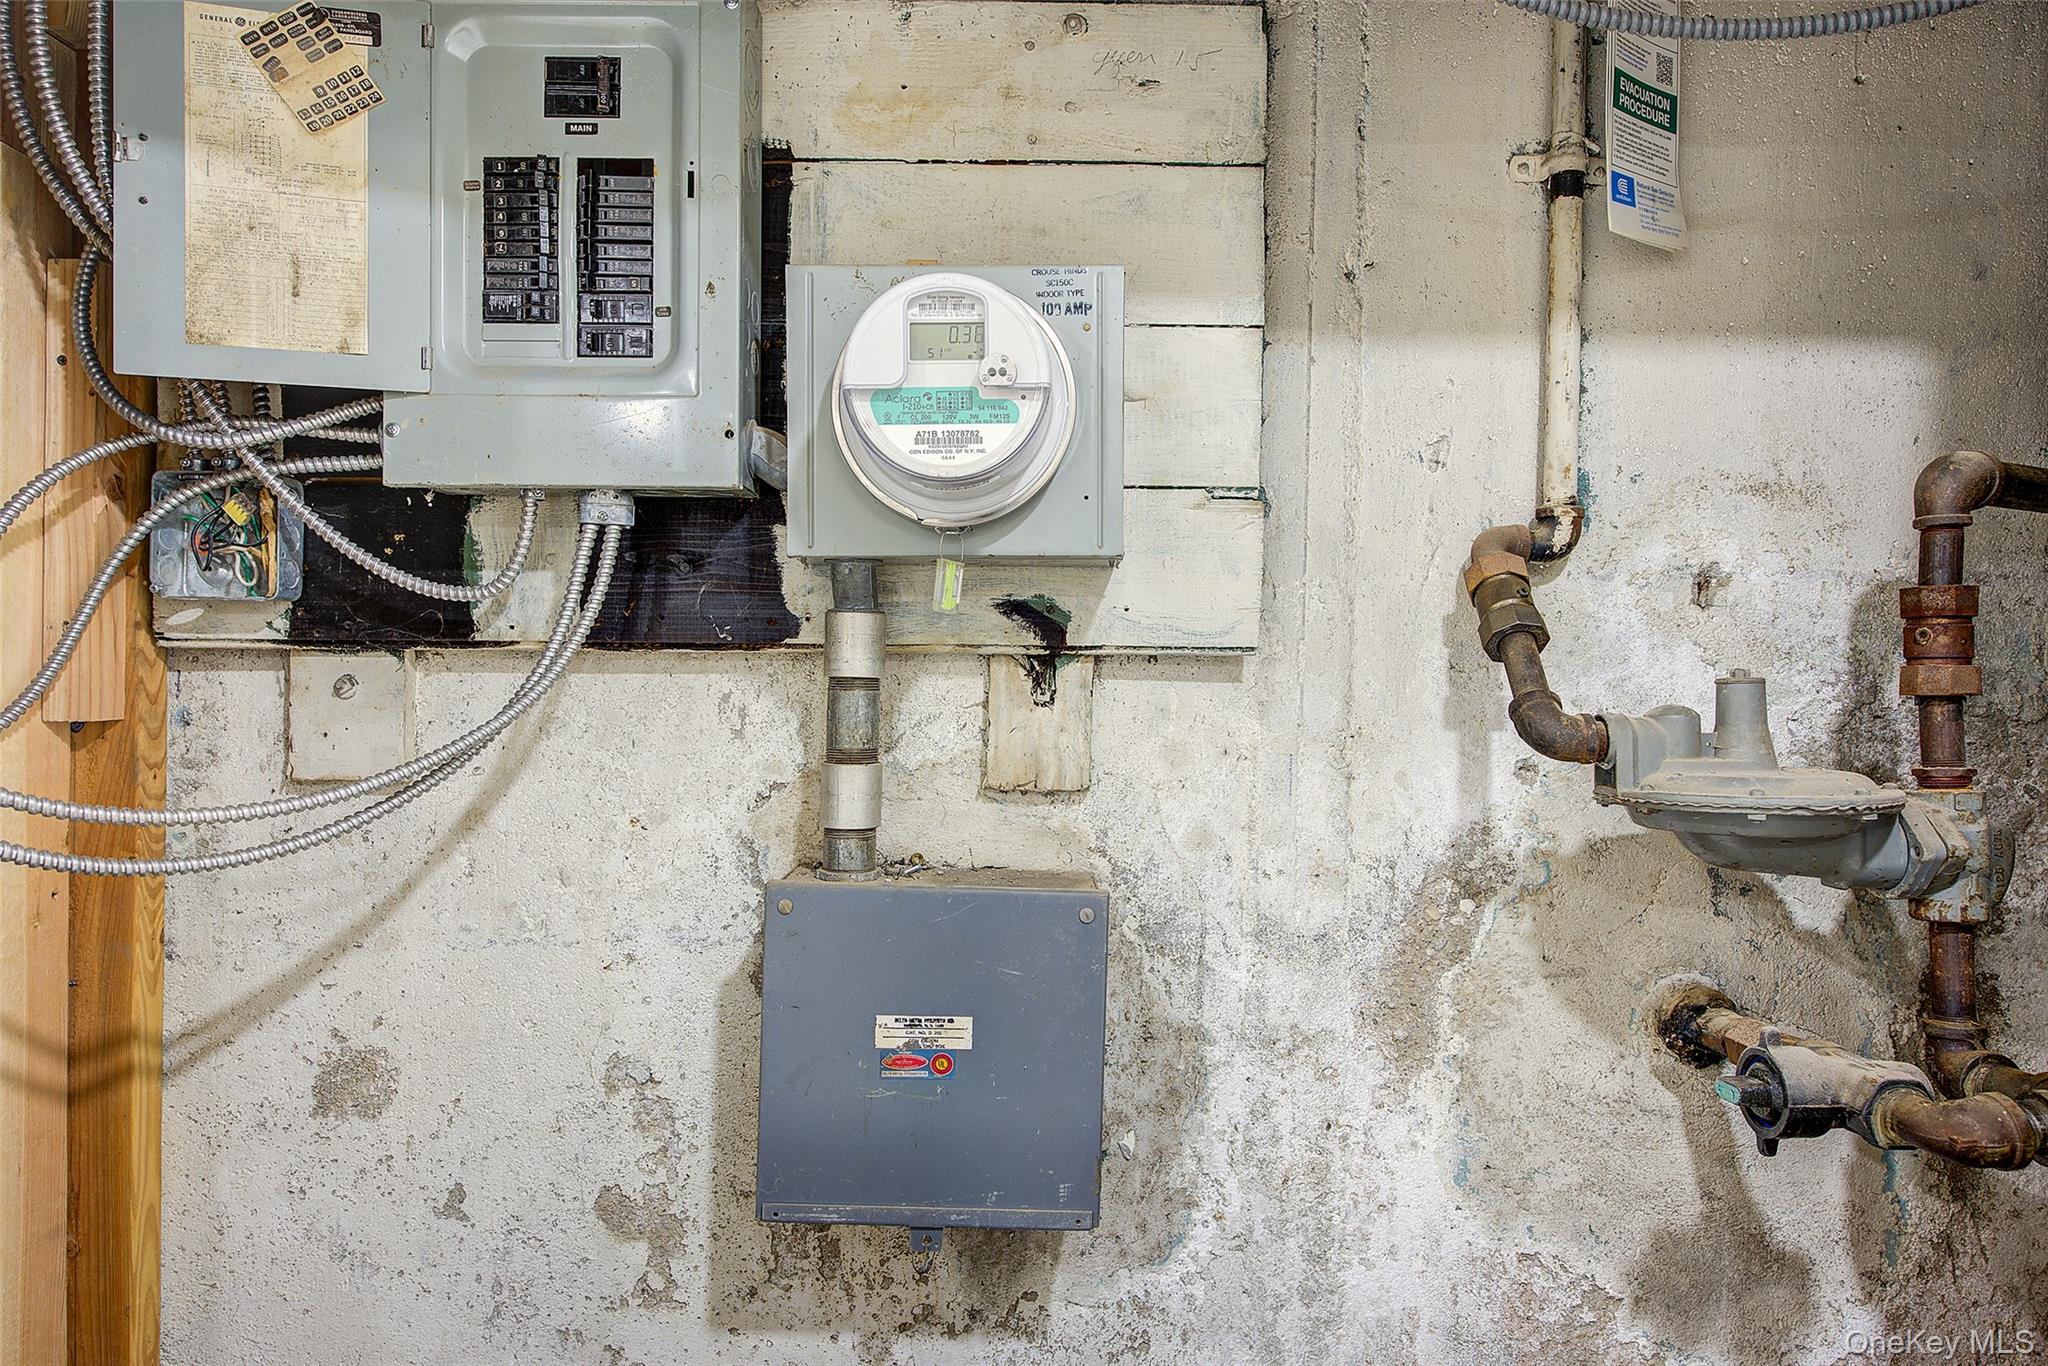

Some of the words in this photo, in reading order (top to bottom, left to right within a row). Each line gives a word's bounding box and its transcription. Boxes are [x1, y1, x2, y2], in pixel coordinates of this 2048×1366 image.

[200, 13, 233, 24] GENERAL
[316, 88, 324, 96] 9
[327, 80, 338, 89] 10
[340, 74, 350, 83] 11
[351, 67, 362, 77] 12
[324, 99, 335, 108] 15
[337, 93, 347, 102] 16
[349, 87, 359, 96] 17
[361, 80, 371, 90] 18
[1620, 76, 1671, 112] EVACUATION
[309, 122, 320, 130] 19
[321, 117, 332, 126] 20
[334, 111, 345, 119] 21
[345, 105, 357, 114] 22
[358, 99, 369, 108] 23
[369, 93, 380, 102] 24
[1619, 92, 1671, 127] PROCEDURE
[499, 197, 504, 205] 3
[1031, 268, 1060, 276] CROUSE
[1067, 289, 1085, 297] TYPE
[610, 304, 618, 314] ON
[1065, 302, 1093, 316] AMP
[607, 338, 614, 347] ON
[941, 430, 980, 438] 13078782
